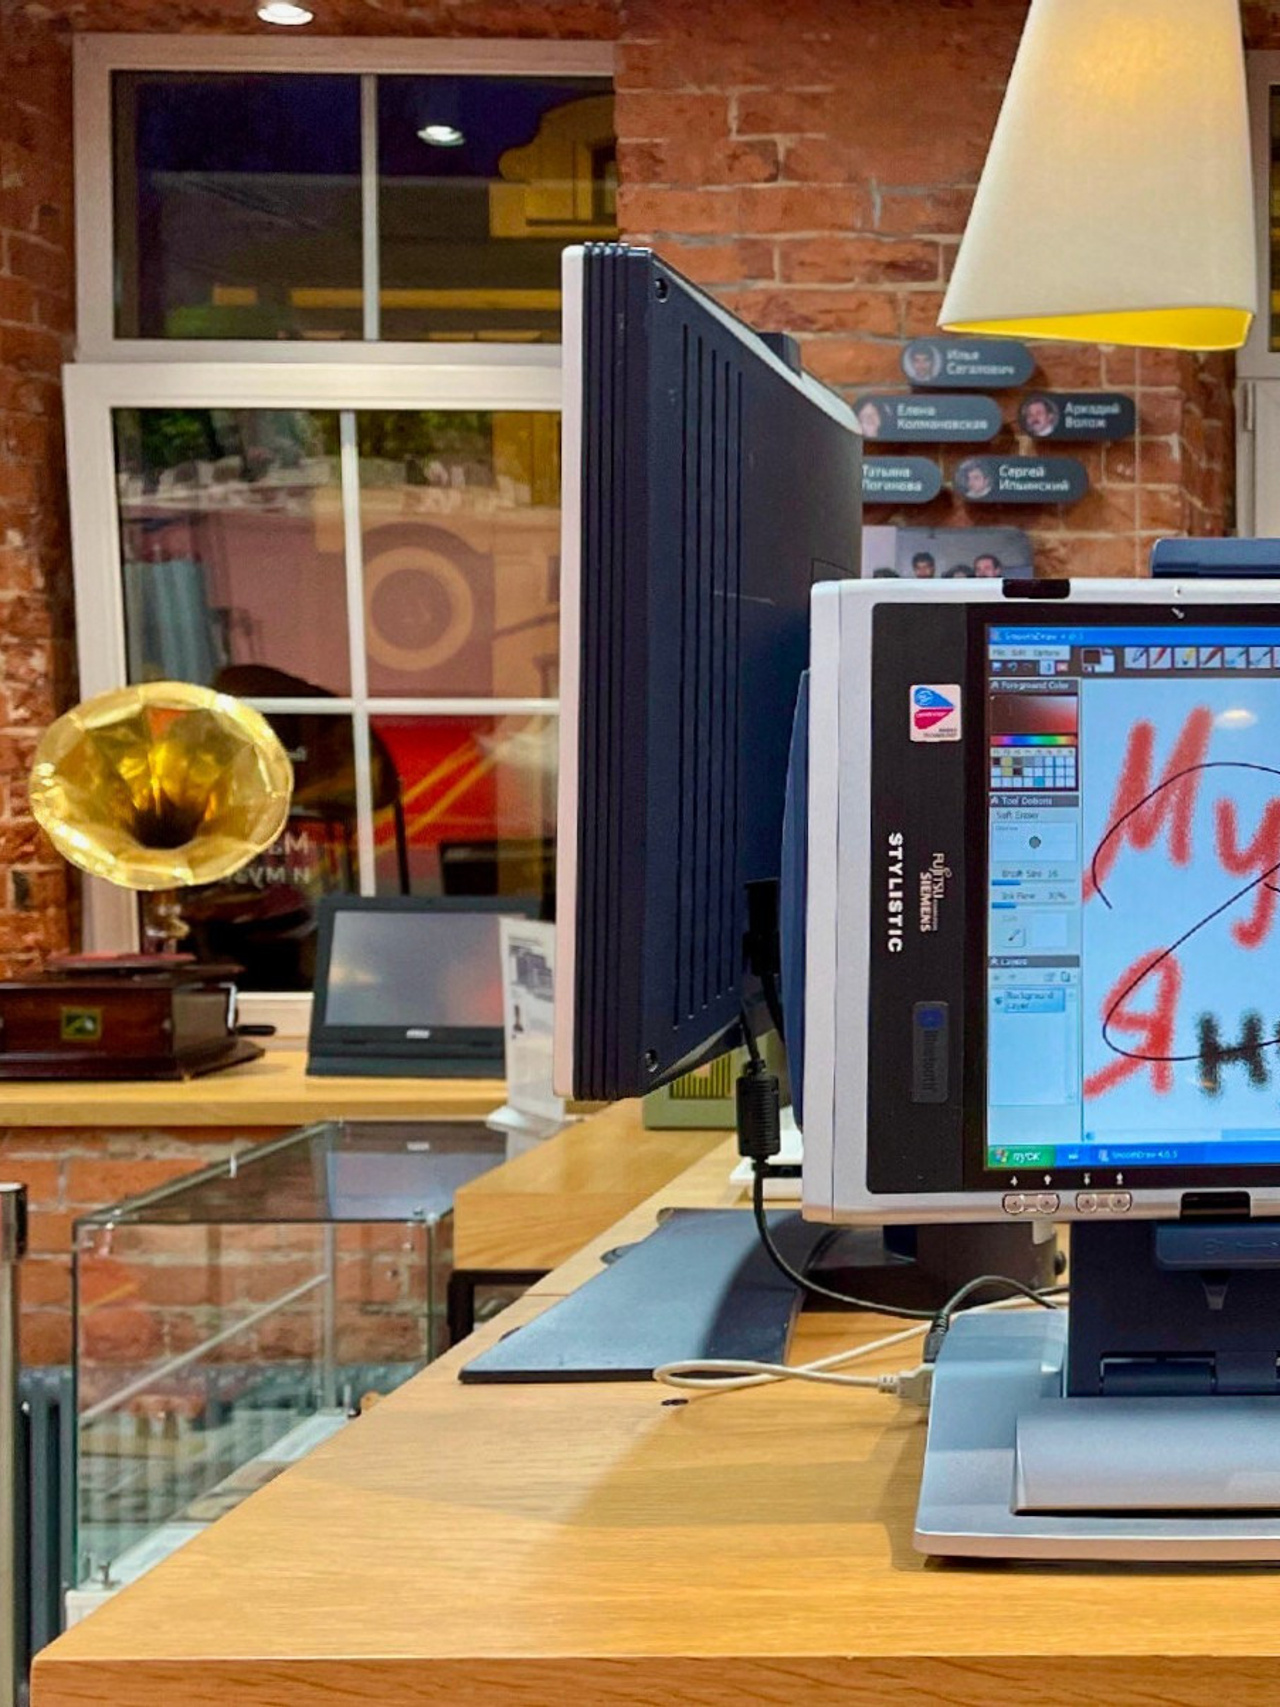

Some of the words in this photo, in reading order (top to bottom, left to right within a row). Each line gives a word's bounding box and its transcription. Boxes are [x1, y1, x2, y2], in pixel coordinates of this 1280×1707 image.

[896, 404, 936, 417] Елена
[1064, 402, 1121, 416] Аркадий
[1064, 416, 1106, 429] Волож
[998, 464, 1046, 479] Сергей
[998, 479, 1071, 492] Ильинский
[1001, 681, 1047, 691] Foreground
[1048, 681, 1069, 690] Color
[888, 832, 904, 953] STYLISTIC
[919, 872, 934, 933] SIEMENS
